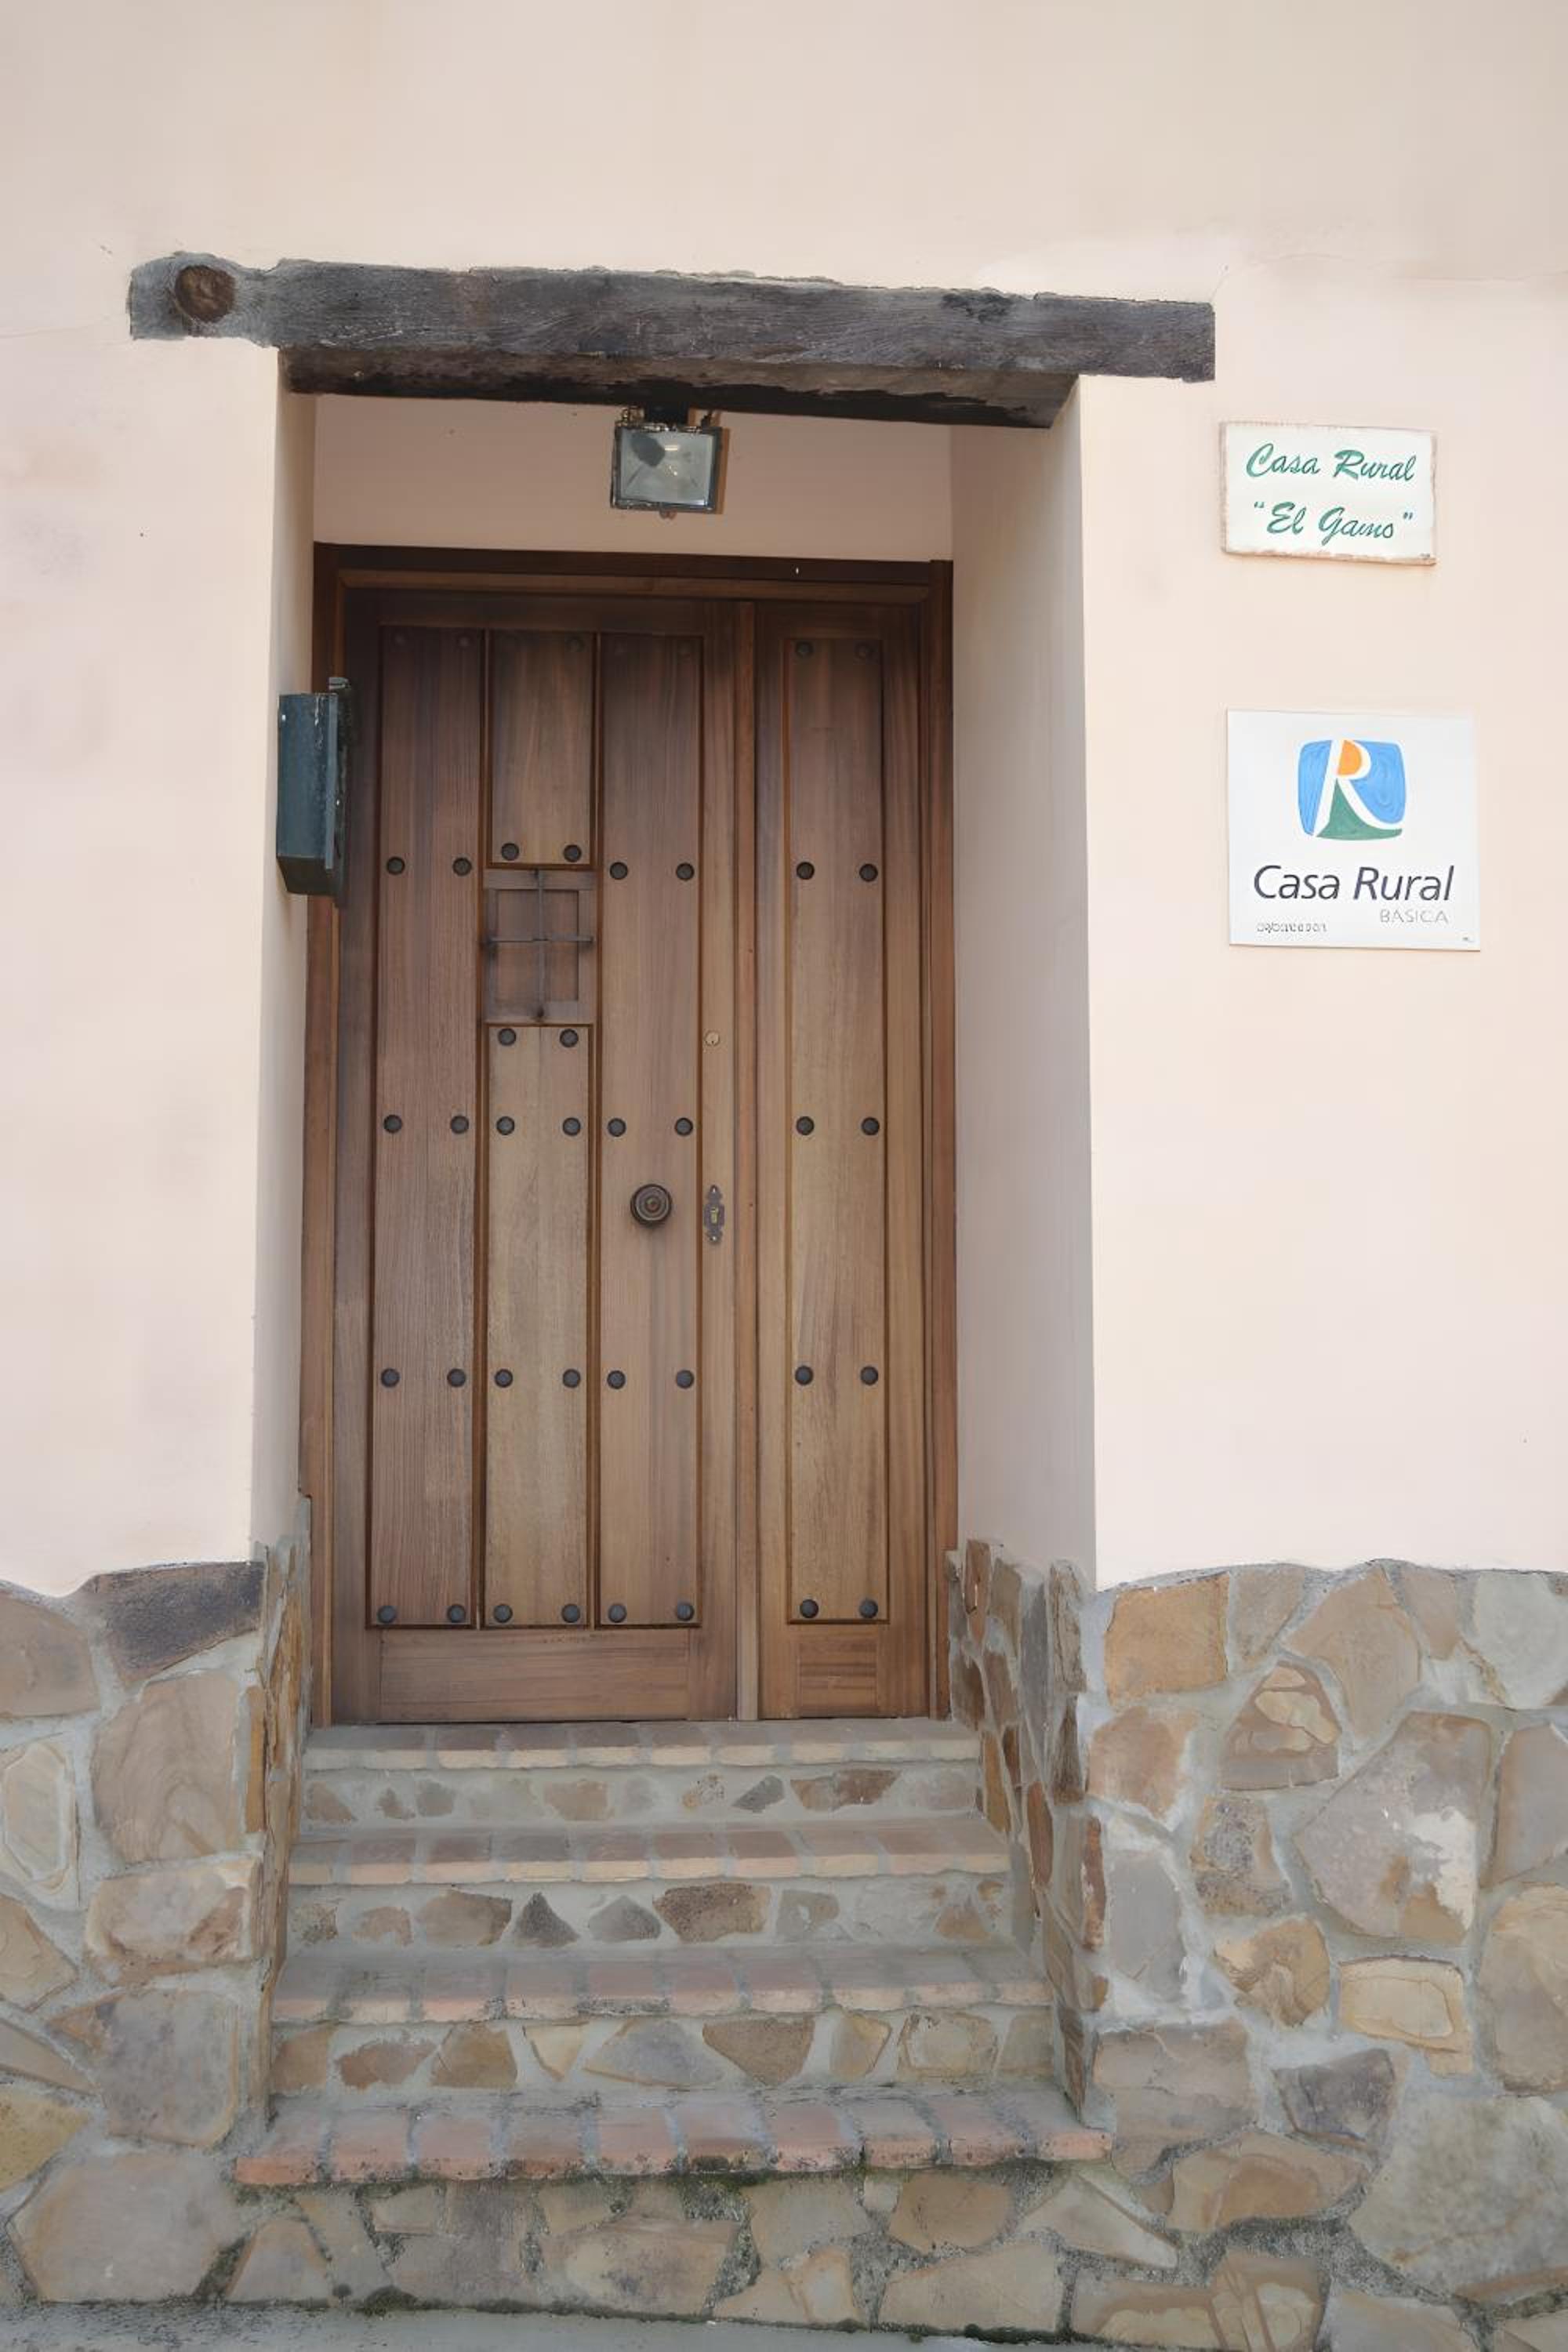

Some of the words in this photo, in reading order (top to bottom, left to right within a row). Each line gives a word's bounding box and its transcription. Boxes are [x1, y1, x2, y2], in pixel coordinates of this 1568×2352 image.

[1247, 442, 1320, 477] Casa
[1333, 449, 1417, 481] Rural
[1254, 865, 1340, 899] Casa
[1353, 865, 1454, 901] Rural
